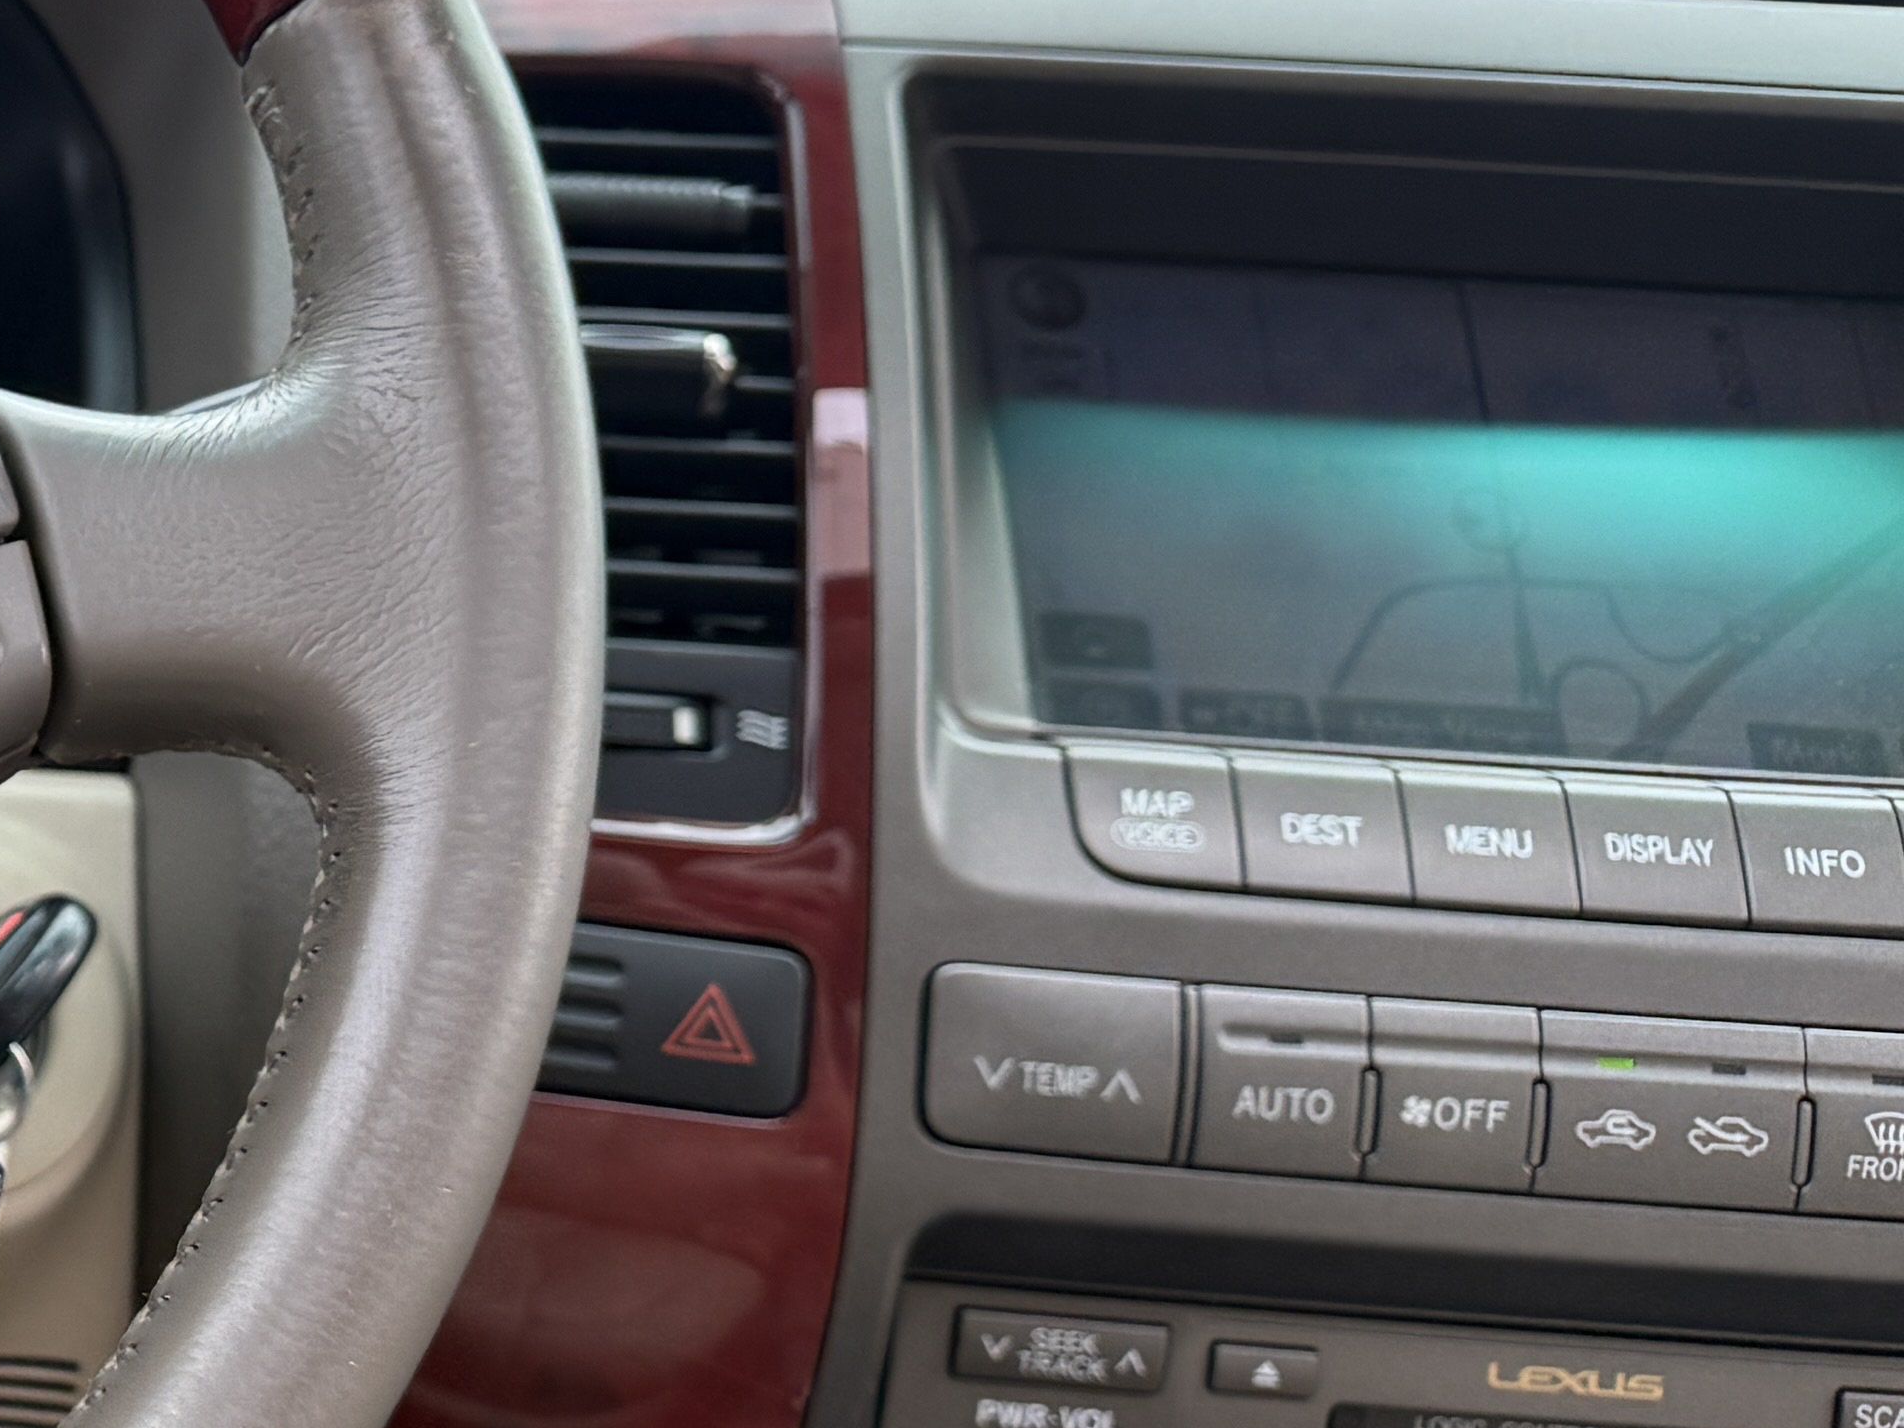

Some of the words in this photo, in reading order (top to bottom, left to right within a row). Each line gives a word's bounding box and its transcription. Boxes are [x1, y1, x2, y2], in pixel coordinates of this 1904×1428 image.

[1120, 787, 1194, 819] MAP
[1281, 812, 1363, 848] DEST
[1444, 824, 1533, 859] MENU
[1604, 832, 1714, 867] DISPLAY
[1785, 846, 1866, 879] INFO
[1019, 1061, 1099, 1098] TEMP
[1232, 1084, 1335, 1125] AUTO
[1433, 1095, 1510, 1132] OFF
[1030, 1326, 1101, 1356] SEEK
[1488, 1361, 1664, 1402] LEXUS
